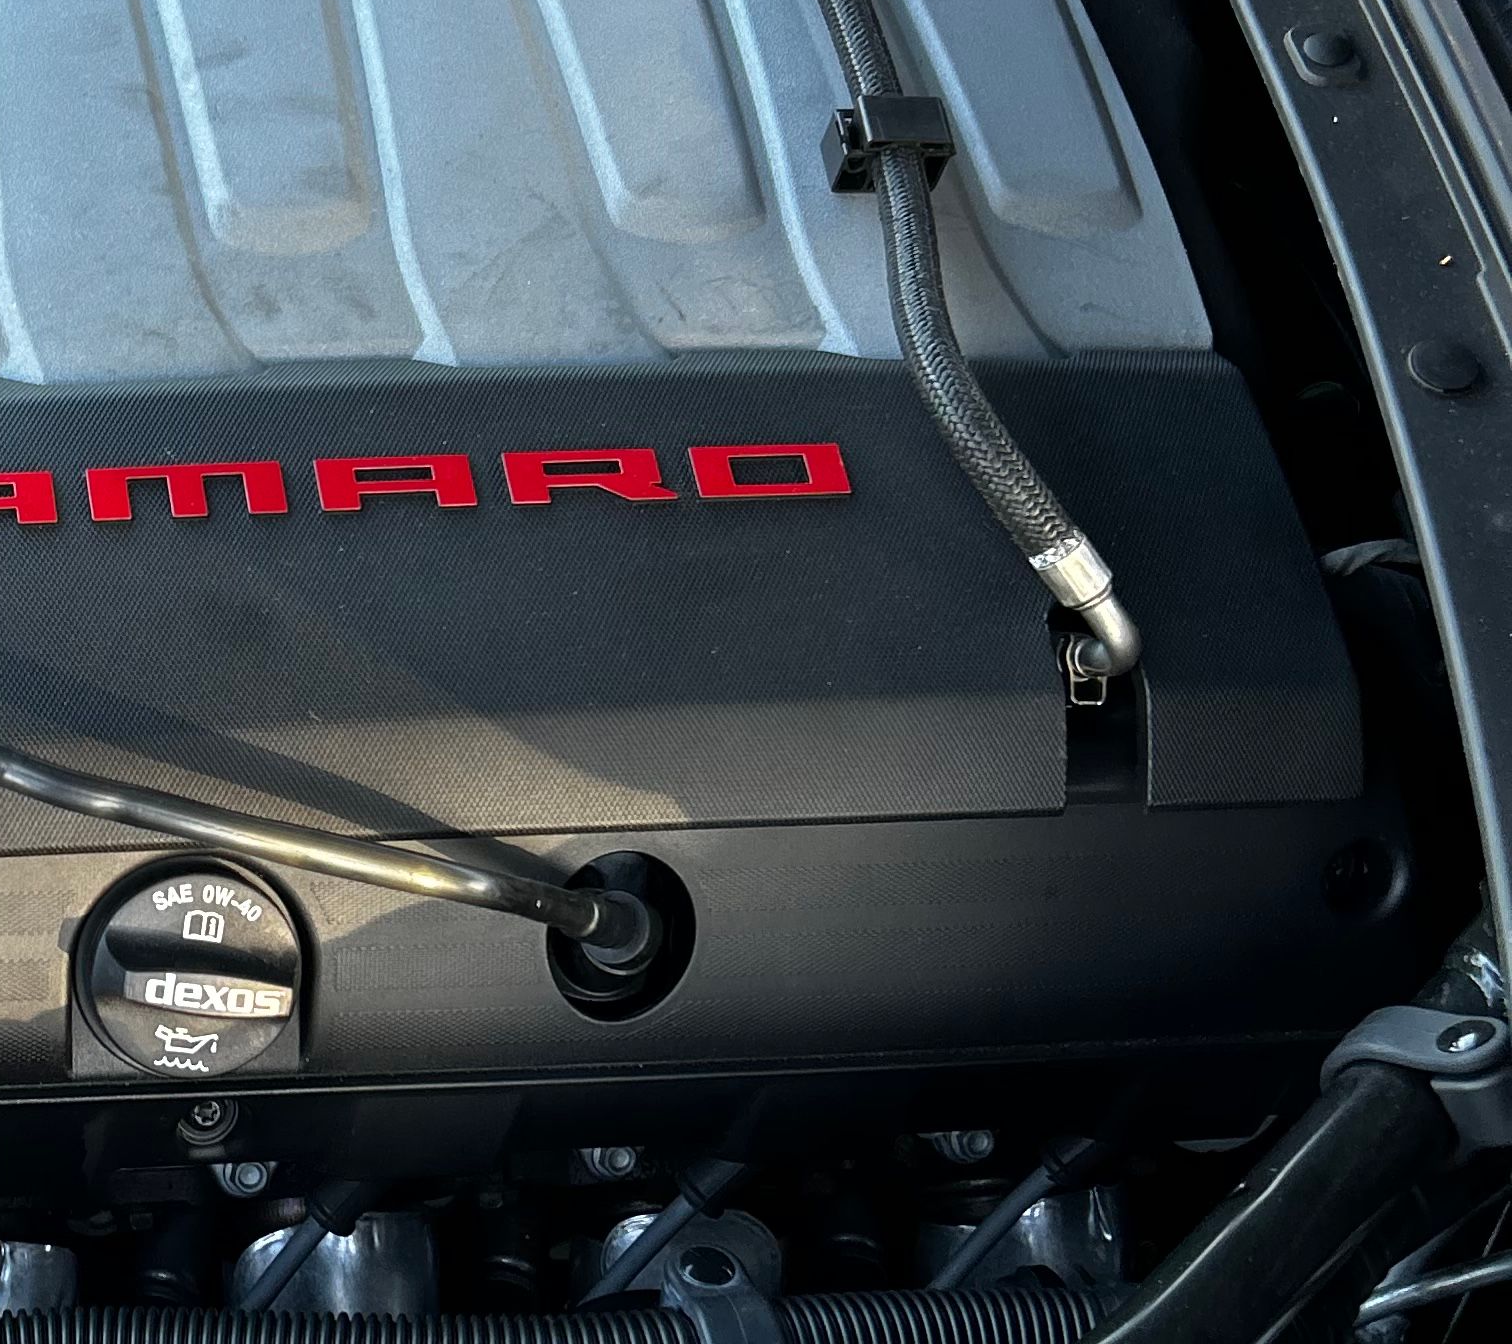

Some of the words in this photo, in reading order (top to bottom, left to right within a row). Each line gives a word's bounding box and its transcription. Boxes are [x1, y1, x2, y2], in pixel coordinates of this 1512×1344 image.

[152, 883, 194, 911] SAE
[202, 884, 263, 922] 0W-40
[145, 972, 285, 1017] dexos
